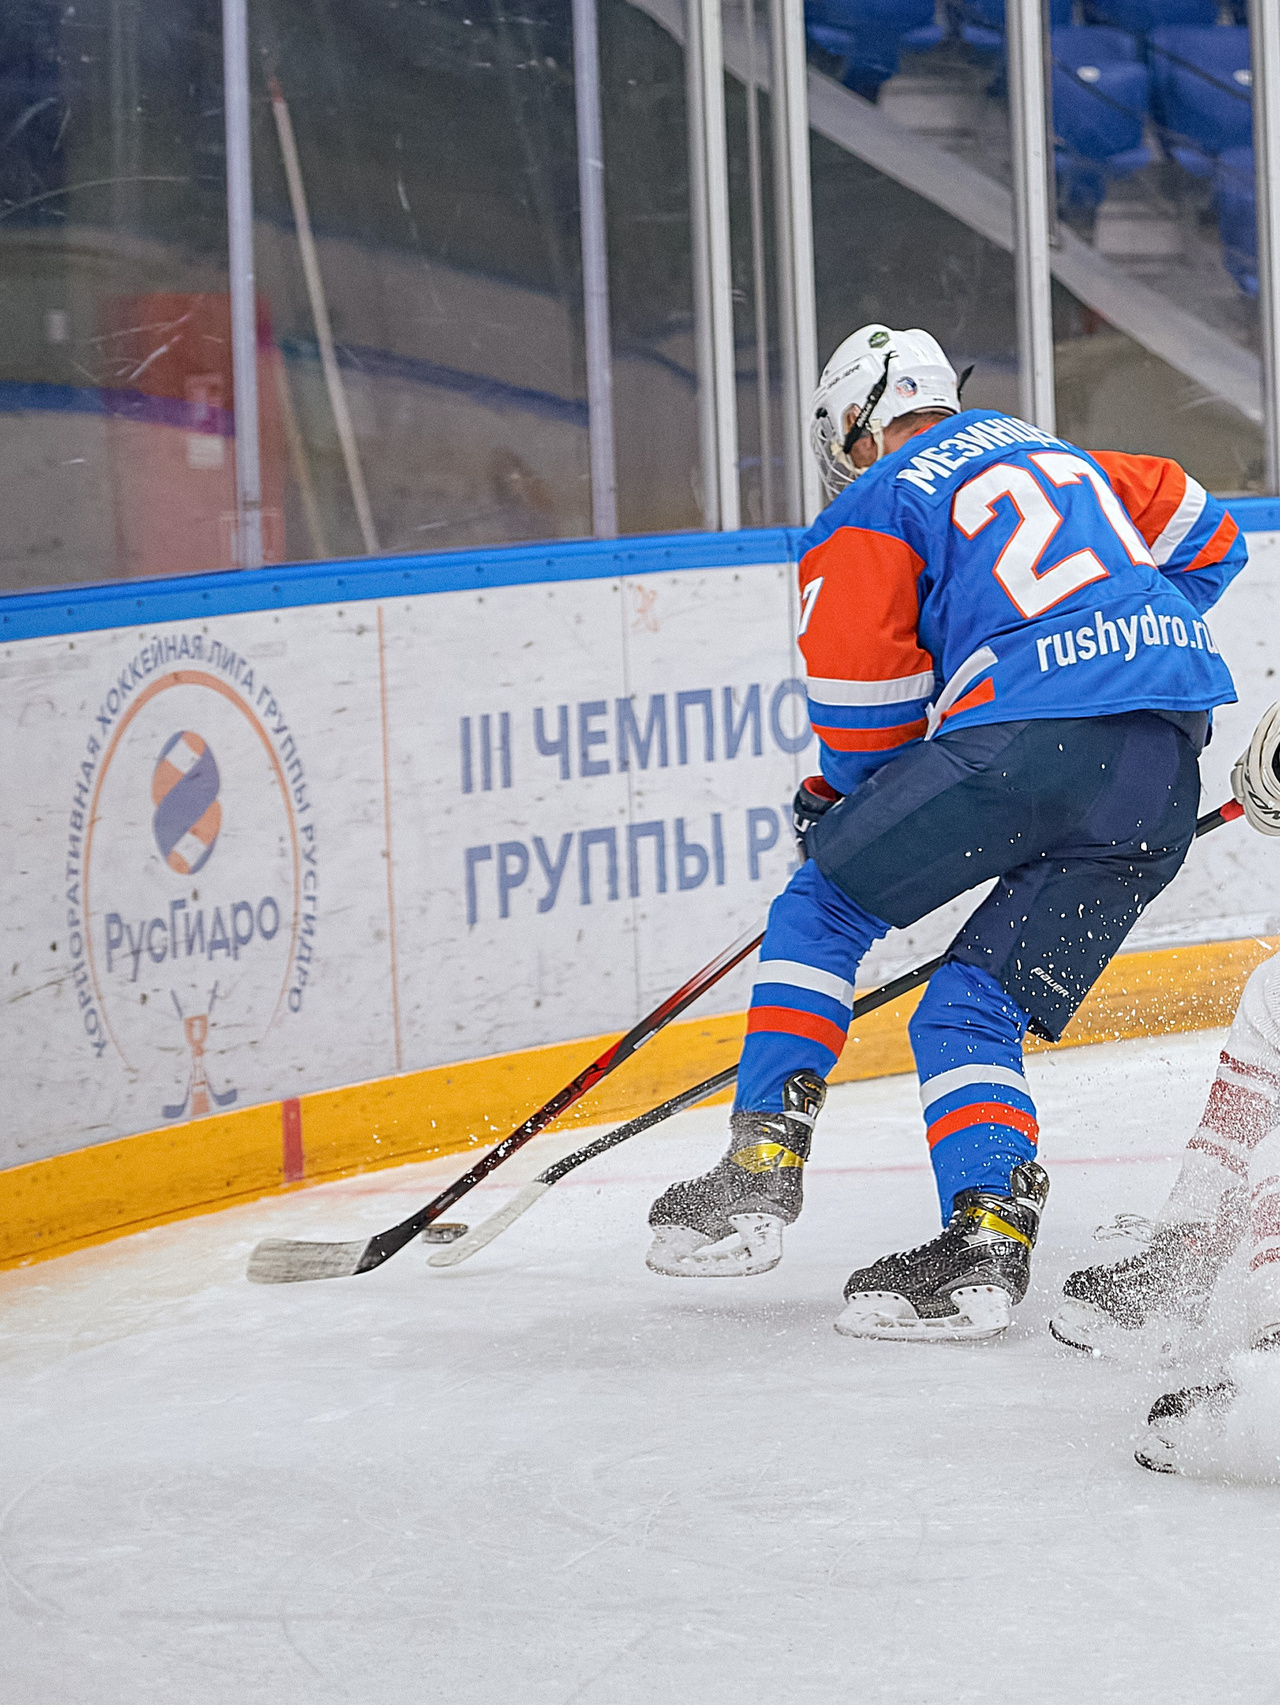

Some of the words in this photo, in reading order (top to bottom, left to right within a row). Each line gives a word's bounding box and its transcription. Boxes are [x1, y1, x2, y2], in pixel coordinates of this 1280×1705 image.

[952, 452, 1157, 620] 27
[66, 734, 107, 1059] КОРПОРАТИВНАЯ
[96, 634, 204, 736] ХОККЕЙНАЯ
[208, 639, 255, 695] ЛИГА
[256, 685, 311, 814] ГРУППЫ
[288, 824, 317, 1013] РУСГИДРО
[464, 812, 725, 925] ГРУППЫ
[105, 896, 281, 982] РусГидро
